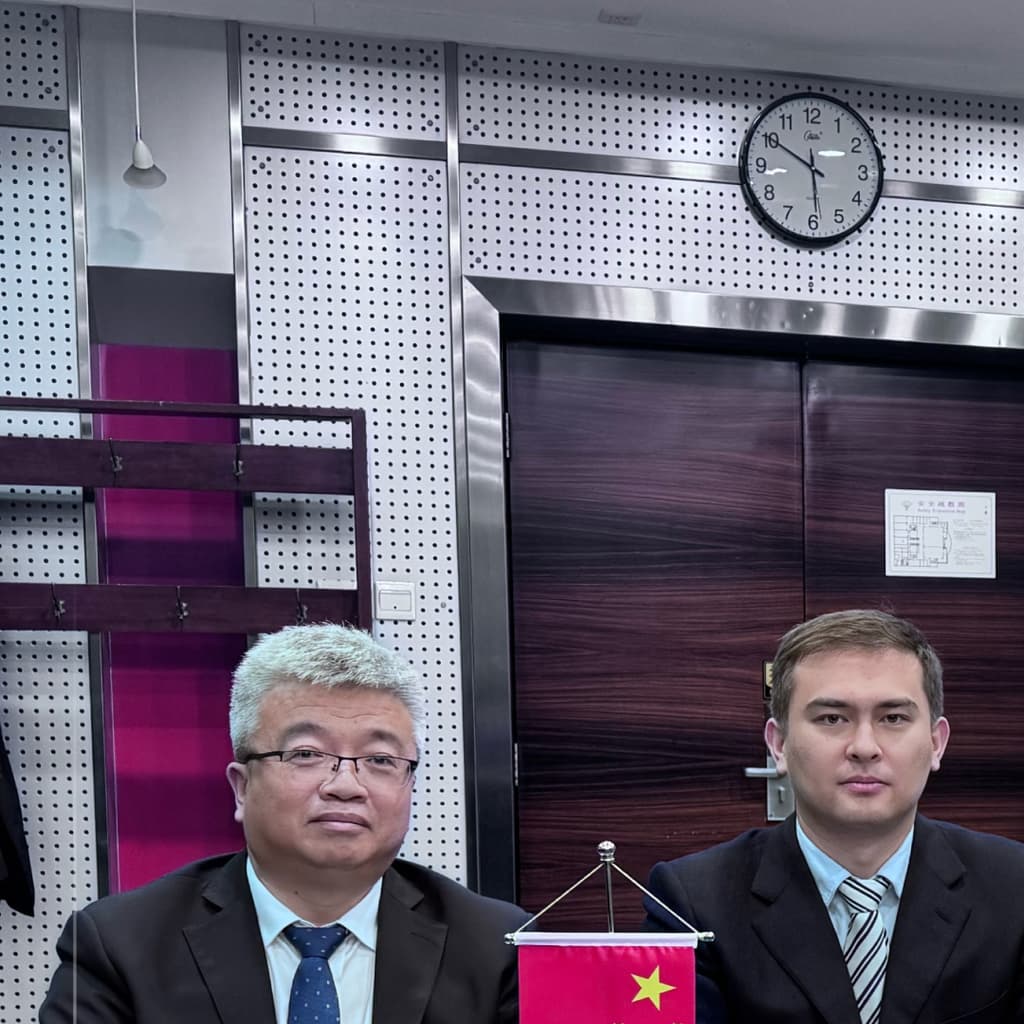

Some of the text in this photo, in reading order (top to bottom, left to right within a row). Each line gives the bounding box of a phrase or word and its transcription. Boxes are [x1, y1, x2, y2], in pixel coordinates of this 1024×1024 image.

[778, 113, 793, 131] 11
[803, 107, 822, 125] 12
[833, 117, 841, 134] 1
[761, 131, 780, 149] 10
[851, 136, 862, 153] 2
[755, 157, 767, 174] 9
[857, 164, 869, 181] 3
[763, 184, 775, 201] 8
[851, 190, 863, 206] 4
[782, 205, 794, 221] 7
[833, 208, 845, 224] 5
[807, 214, 819, 231] 6
